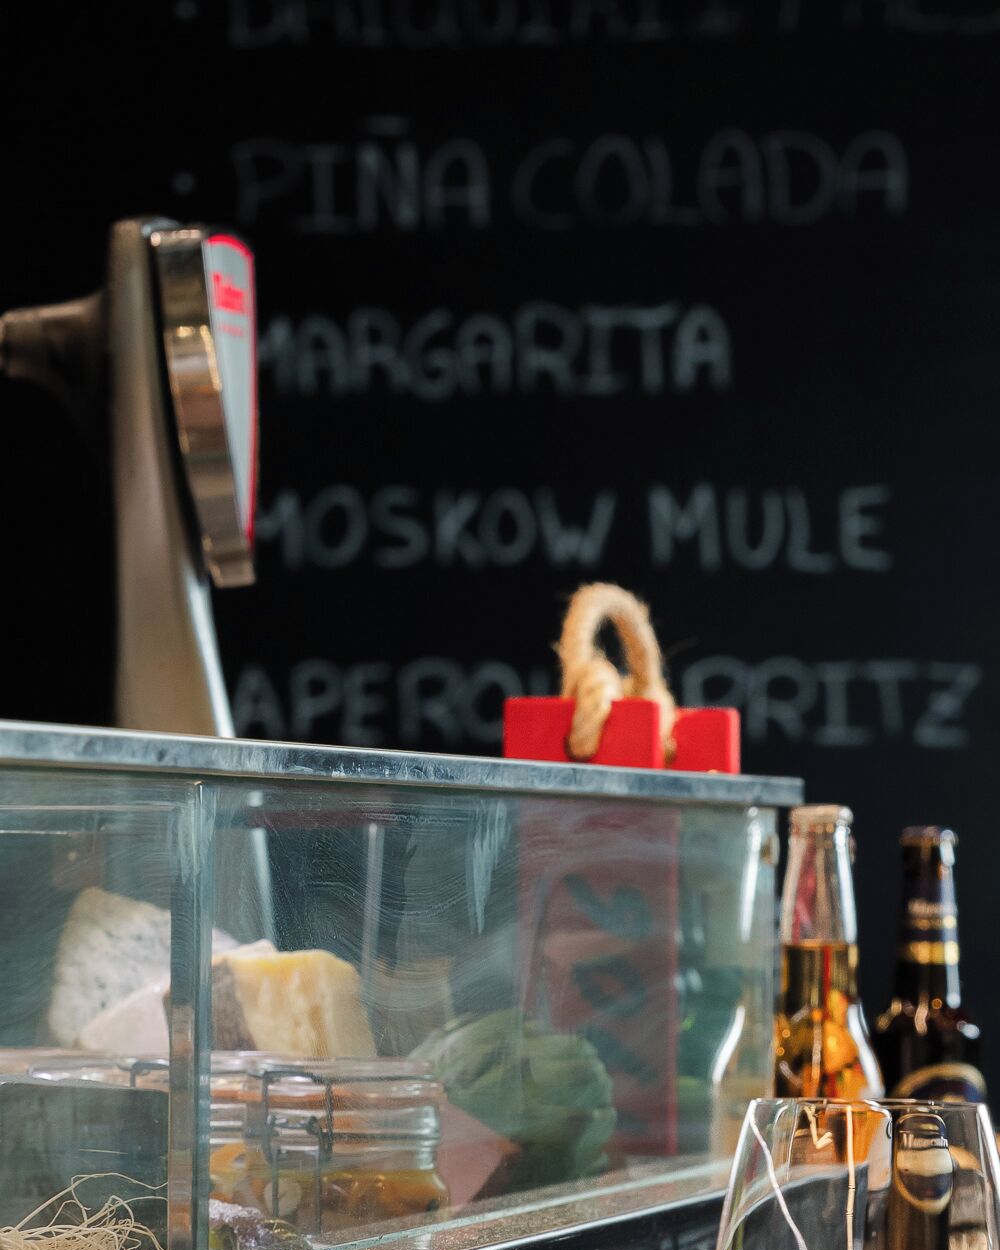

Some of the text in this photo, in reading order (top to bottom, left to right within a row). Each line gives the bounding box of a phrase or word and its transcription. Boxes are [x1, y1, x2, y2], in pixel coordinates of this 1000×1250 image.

[229, 114, 911, 233] PIÑA COLADA
[646, 480, 893, 573] MULE
